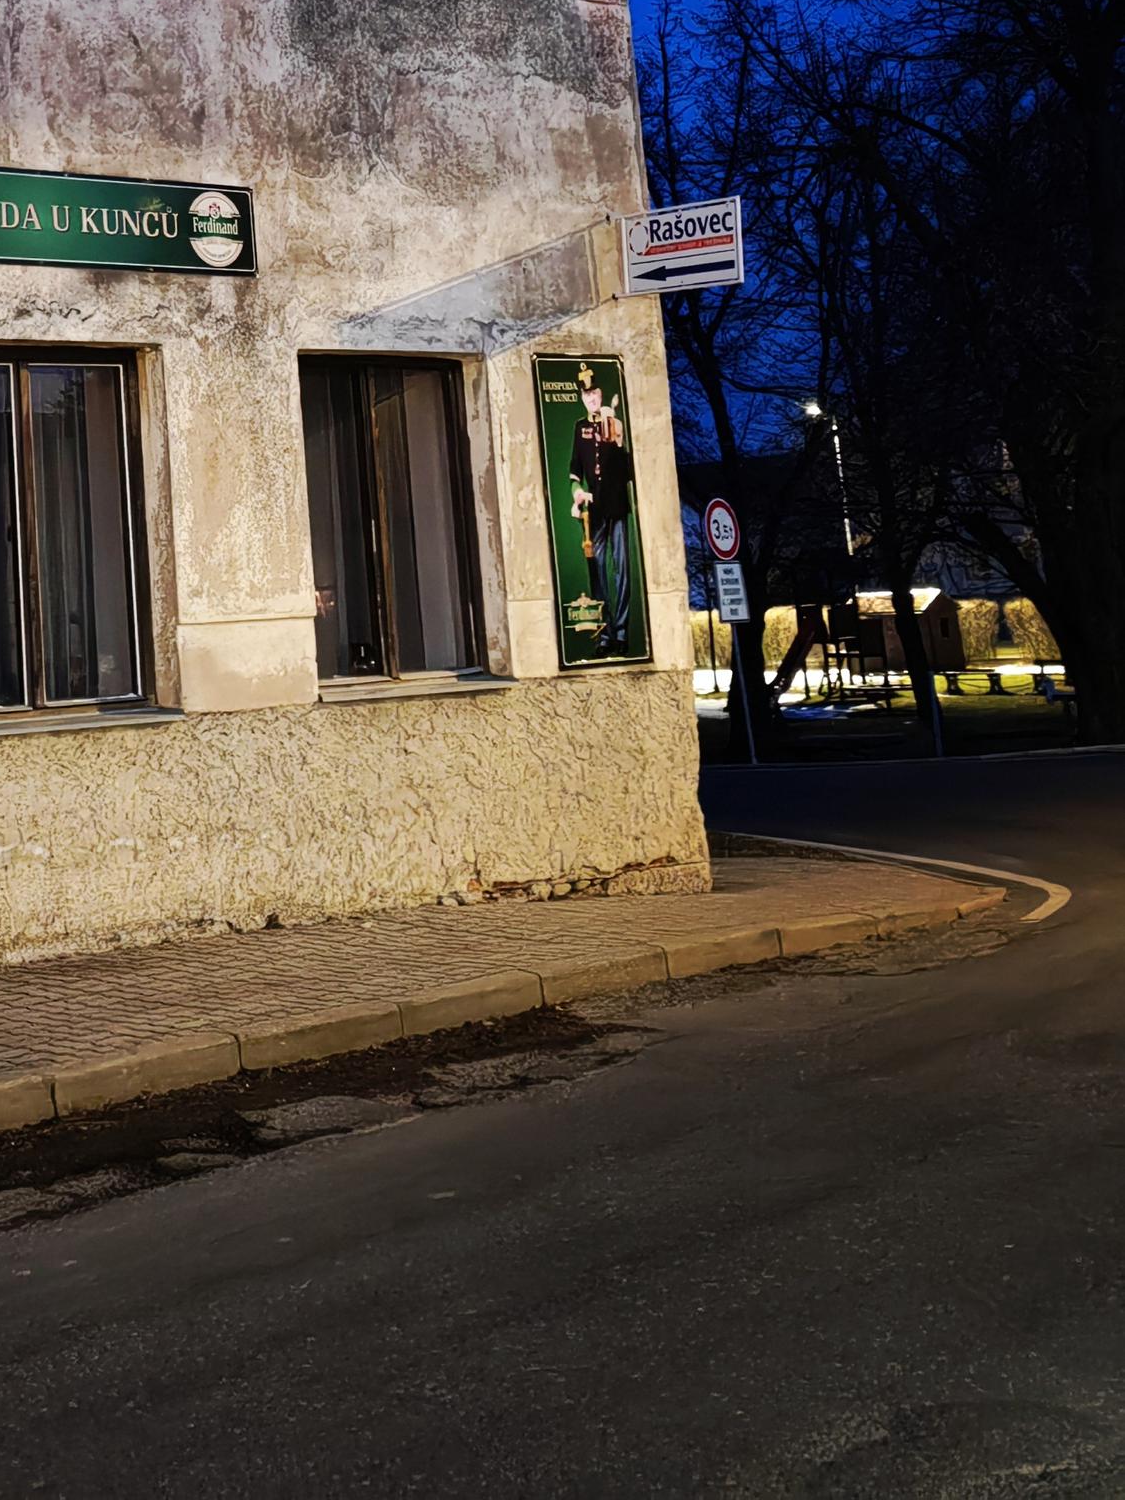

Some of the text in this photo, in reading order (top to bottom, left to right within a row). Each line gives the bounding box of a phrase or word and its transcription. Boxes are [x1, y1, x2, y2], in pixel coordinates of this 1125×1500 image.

[50, 204, 70, 232] U
[79, 205, 179, 239] KUNCŮ
[192, 216, 239, 235] Ferdinand
[649, 211, 734, 243] Rašovec
